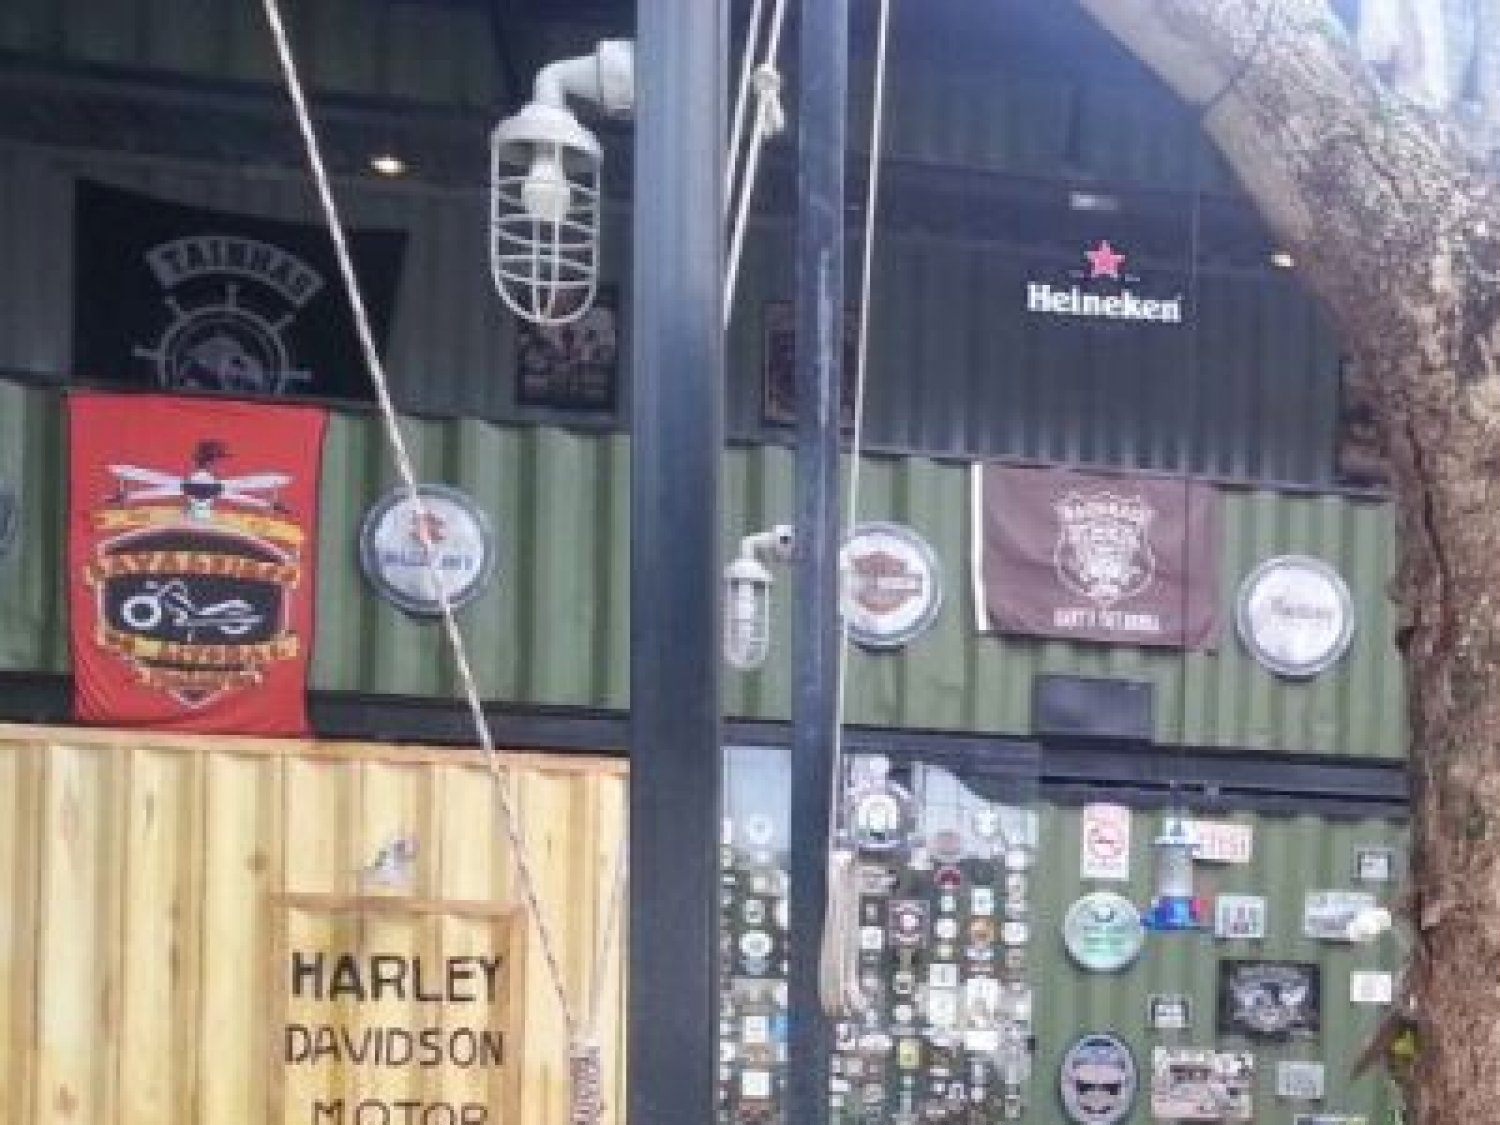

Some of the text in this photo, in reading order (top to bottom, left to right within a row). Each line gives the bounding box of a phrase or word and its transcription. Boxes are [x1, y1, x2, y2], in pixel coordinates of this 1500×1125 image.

[1027, 281, 1182, 323] Heineken
[292, 951, 503, 1005] HARLEY
[284, 1023, 504, 1069] DAVIDSON
